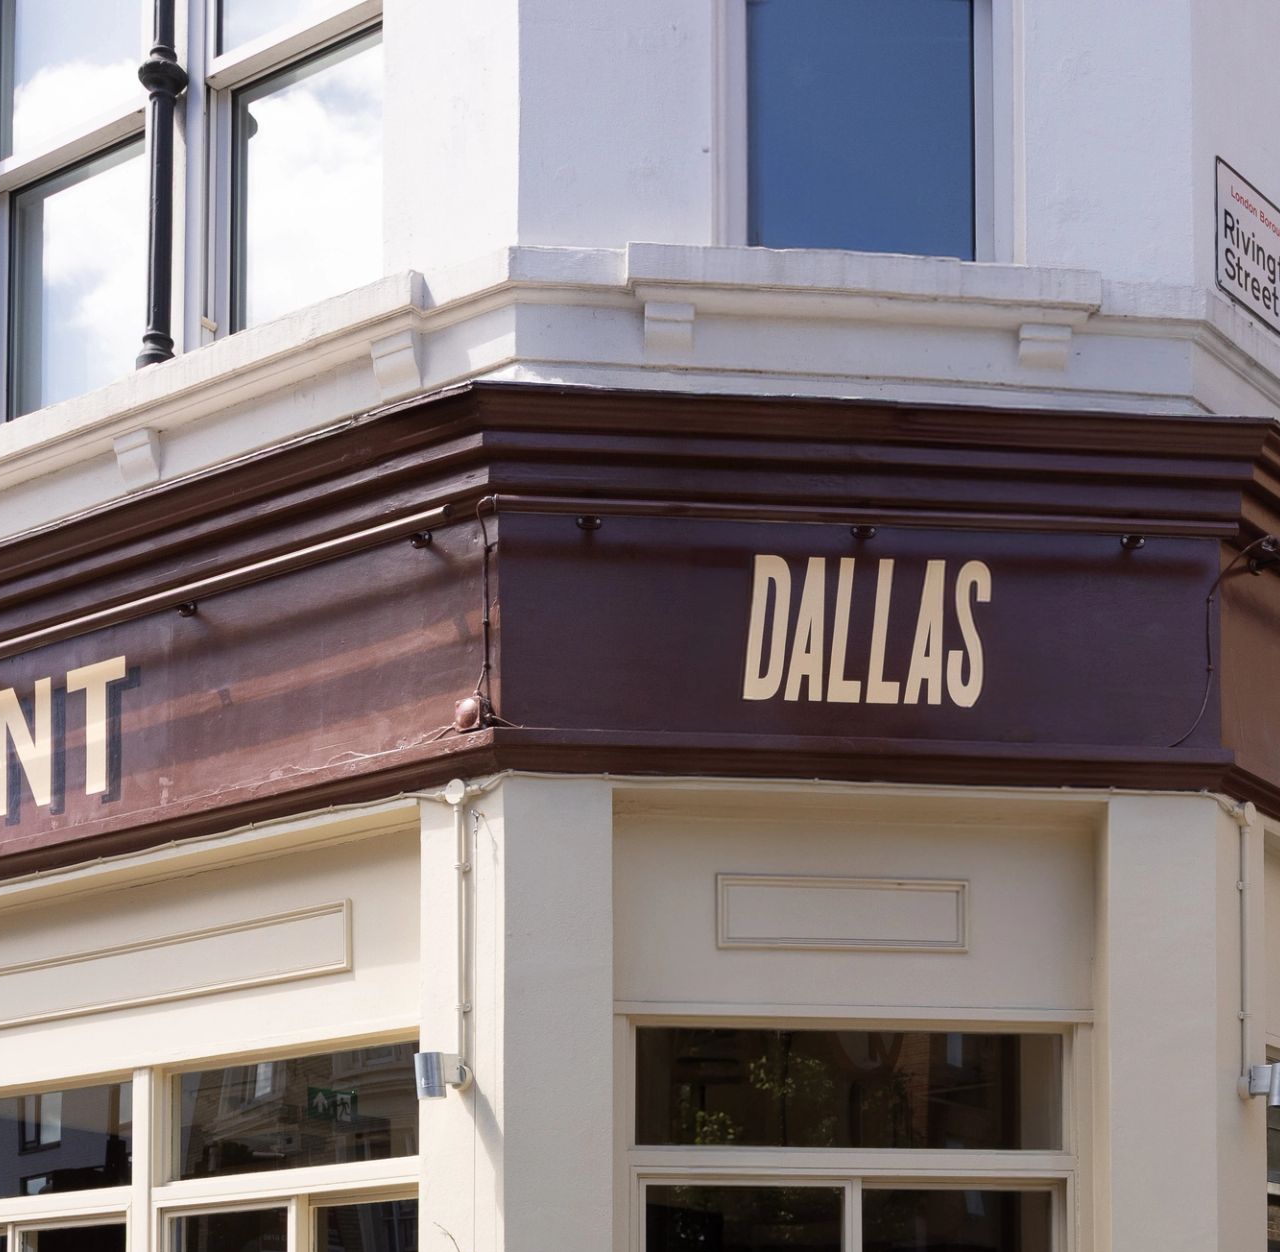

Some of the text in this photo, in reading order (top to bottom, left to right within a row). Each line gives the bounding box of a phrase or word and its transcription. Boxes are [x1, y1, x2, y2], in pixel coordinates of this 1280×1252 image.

[1230, 184, 1258, 218] London
[1224, 248, 1279, 317] Street
[742, 554, 992, 708] DALLAS
